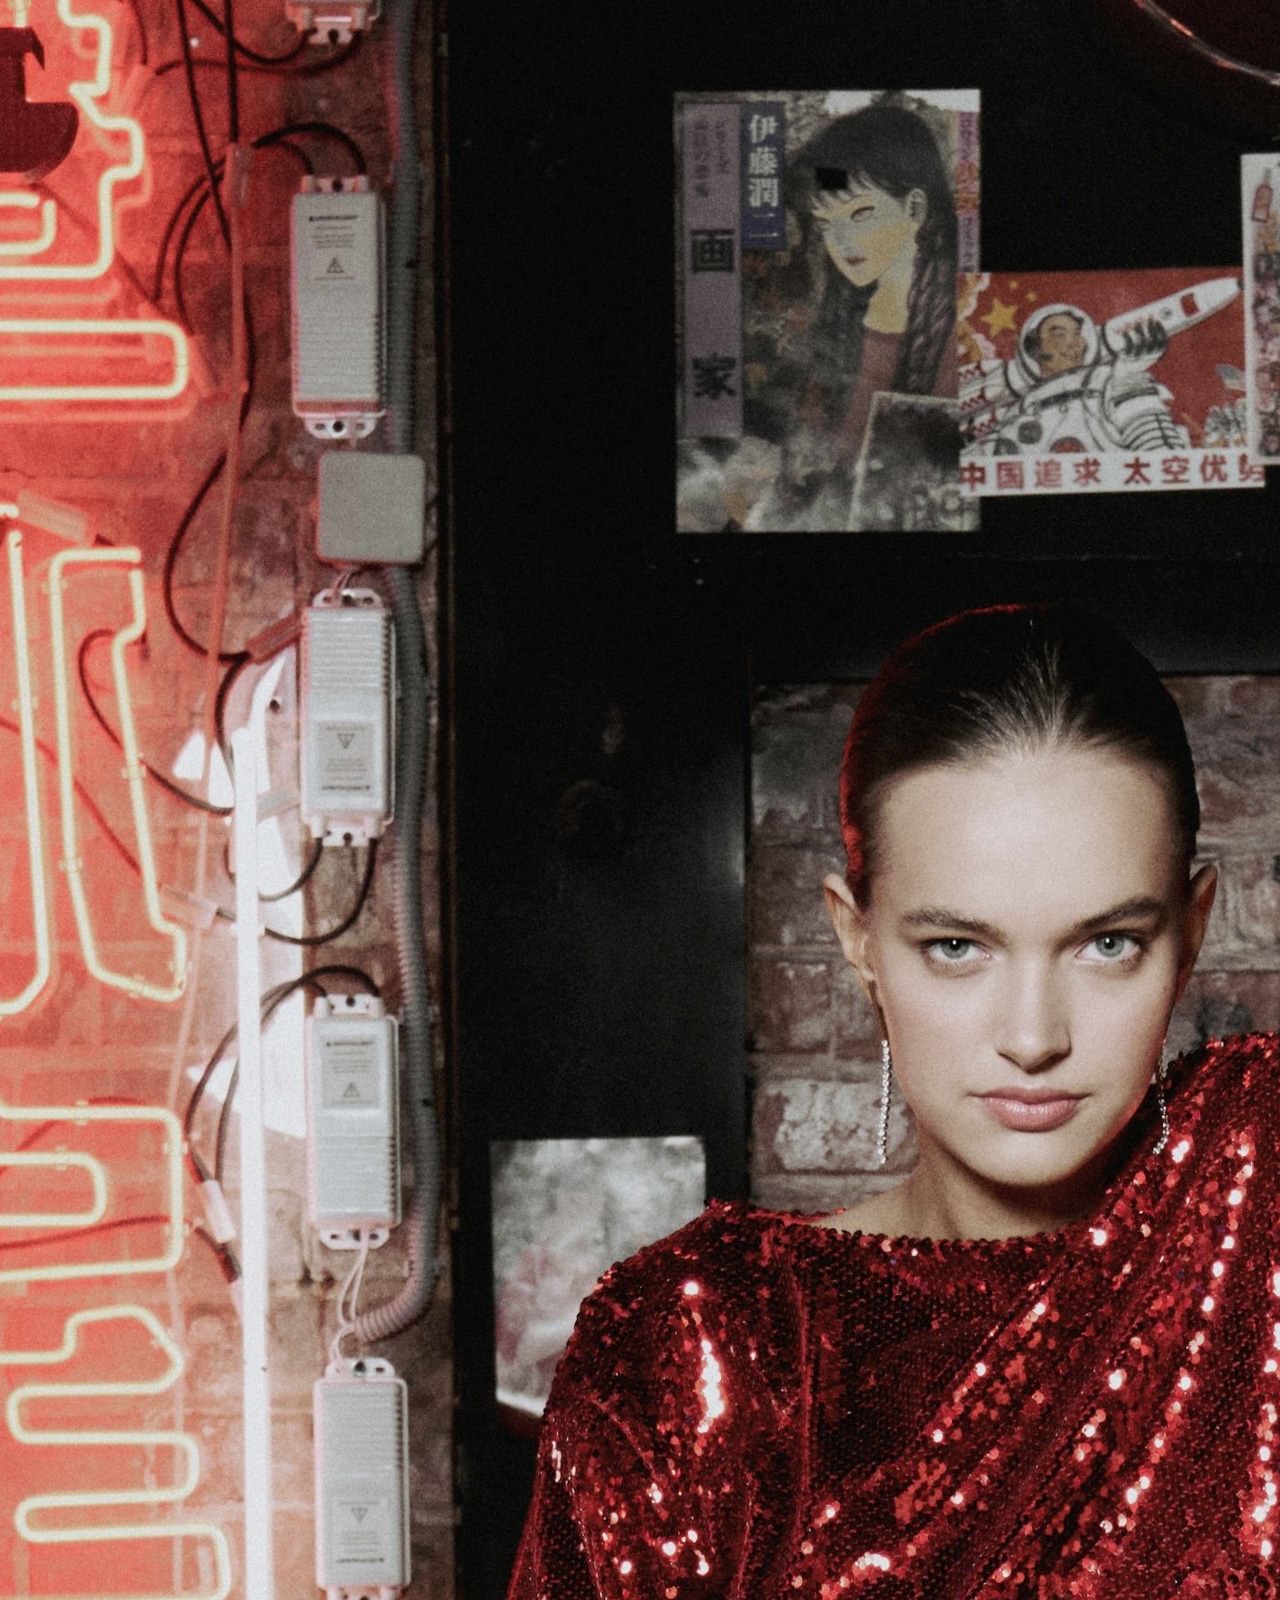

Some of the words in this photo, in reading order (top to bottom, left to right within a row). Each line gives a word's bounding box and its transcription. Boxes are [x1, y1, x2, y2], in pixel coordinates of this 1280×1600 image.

[748, 114, 780, 237] 伊藤潤二
[690, 228, 737, 400] 画家
[958, 458, 1102, 491] 中国追求
